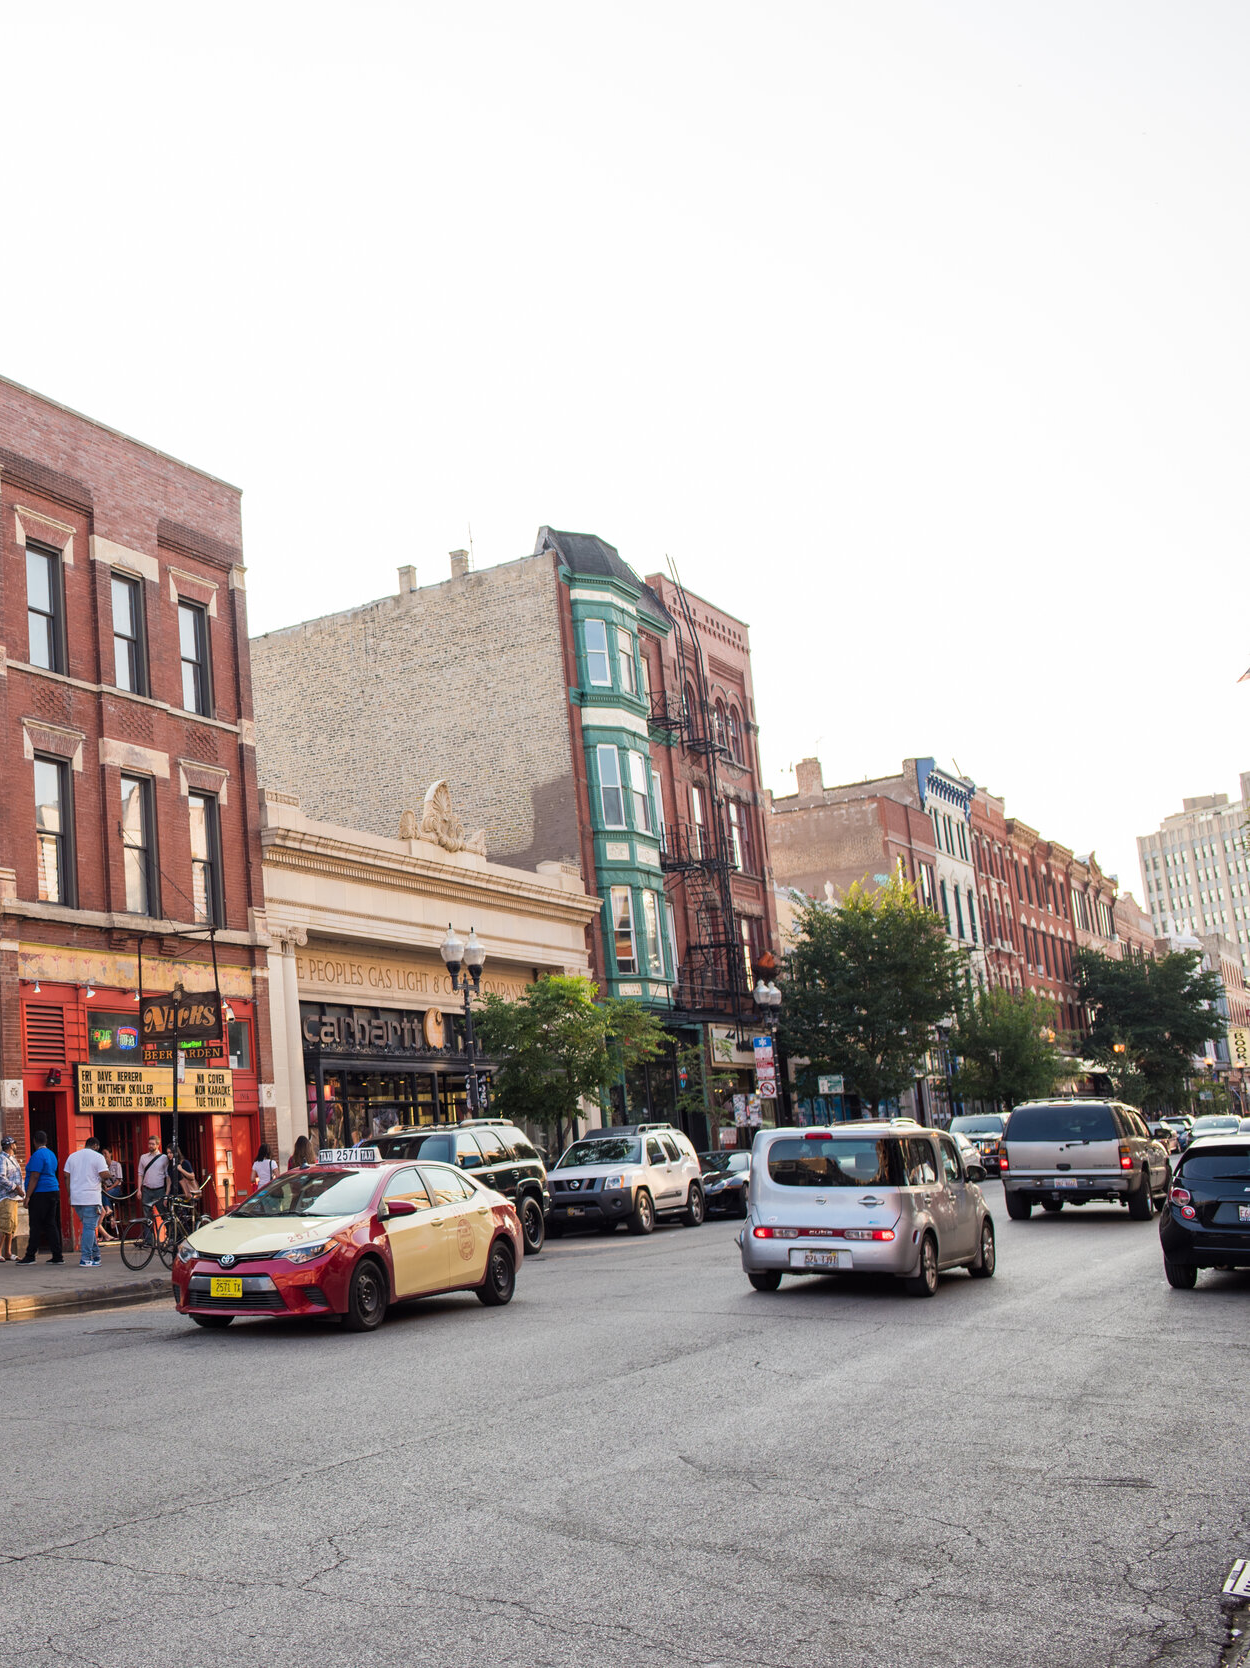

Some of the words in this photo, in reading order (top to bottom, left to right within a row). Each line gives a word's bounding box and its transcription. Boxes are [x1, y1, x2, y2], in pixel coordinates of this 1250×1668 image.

[309, 959, 363, 986] PEOPLES
[368, 966, 392, 989] GAS
[397, 969, 429, 993] LIGHT
[303, 1012, 422, 1049] carhartt
[144, 1050, 173, 1061] BEER
[182, 1047, 221, 1059] ARDEN
[1234, 1032, 1249, 1067] BOOK
[81, 1070, 92, 1082] FRI
[97, 1070, 112, 1082] DAVE
[117, 1071, 143, 1082] HERRERO
[196, 1073, 205, 1084] NO
[207, 1073, 225, 1084] COVER
[81, 1083, 93, 1094] SAT
[97, 1084, 126, 1095] MATTHEW
[128, 1084, 154, 1095] SKOLLER
[207, 1085, 231, 1096] KARAOKE
[81, 1096, 94, 1107] SUN
[97, 1096, 105, 1107] $2
[108, 1096, 133, 1107] BOTTLES
[136, 1096, 143, 1107] $3
[144, 1096, 167, 1107] DRAFTS
[196, 1097, 206, 1108] TUE
[207, 1097, 227, 1108] TRIVIA
[320, 1152, 332, 1162] TAXI
[336, 1150, 358, 1161] 2571
[361, 1150, 374, 1161] TAXI
[216, 1282, 230, 1293] 2571
[234, 1283, 241, 1293] TX
